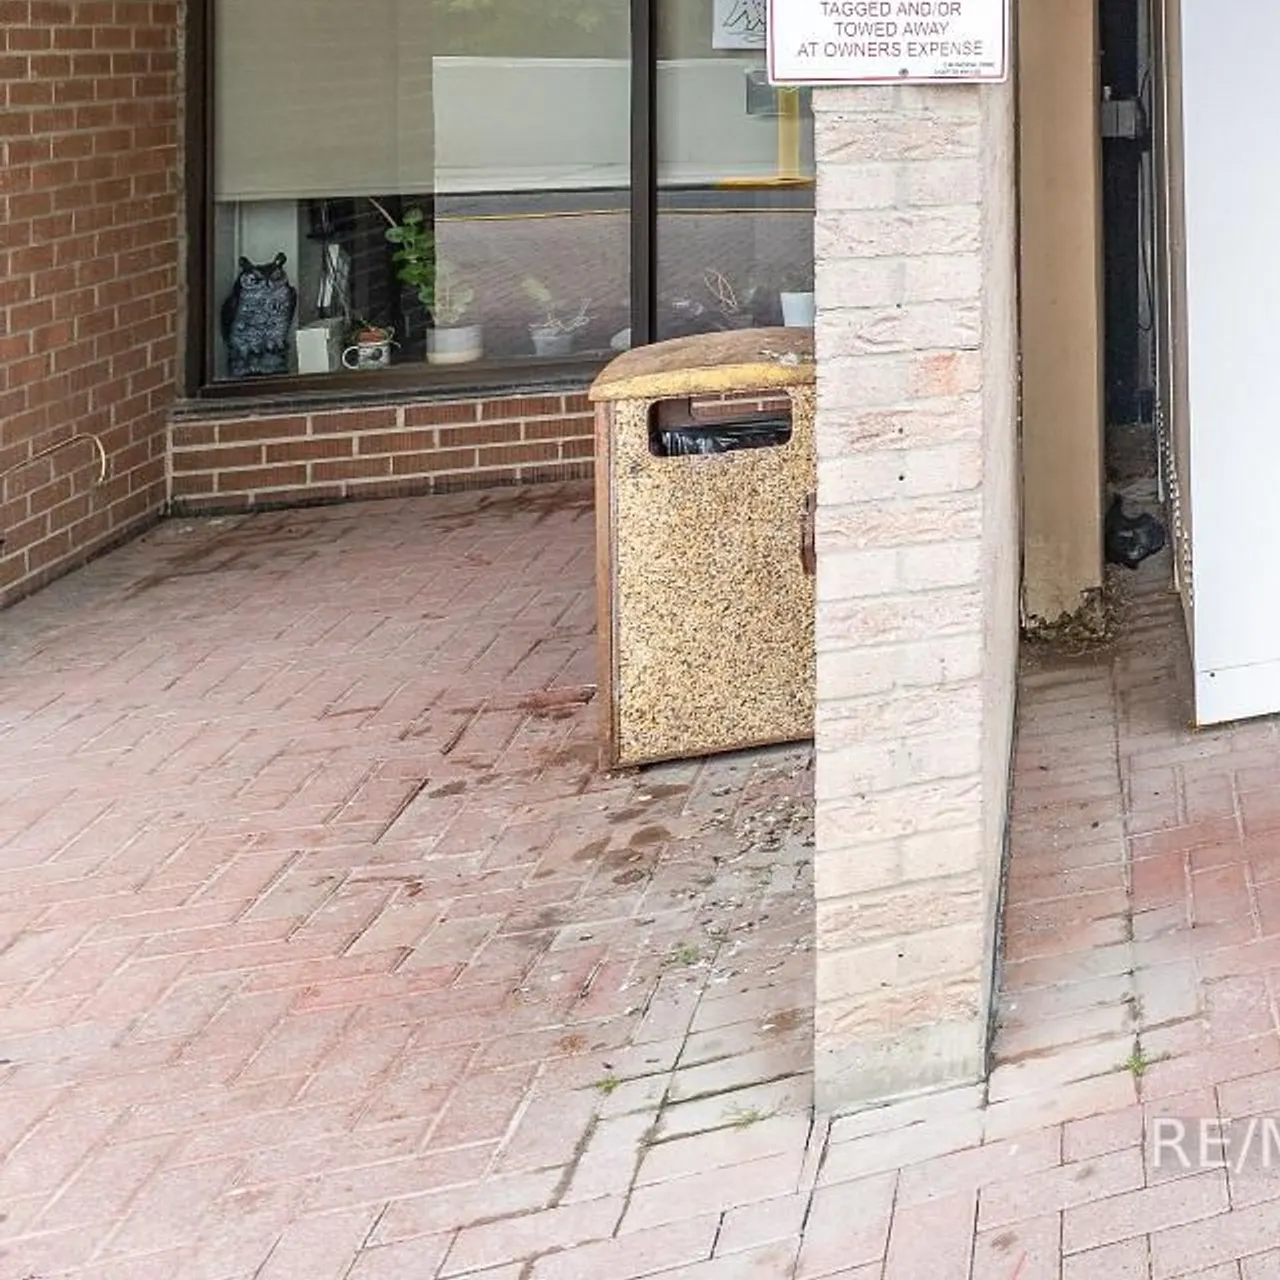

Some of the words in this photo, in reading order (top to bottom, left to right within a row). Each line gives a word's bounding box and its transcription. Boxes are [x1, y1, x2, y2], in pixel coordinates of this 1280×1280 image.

[820, 1, 891, 17] TAGGED
[897, 1, 962, 17] AND/OR
[834, 21, 898, 37] TOWED
[903, 21, 950, 36] AWAY
[798, 42, 819, 57] AT
[824, 41, 901, 57] OWNERS
[907, 40, 983, 57] EXPENSE
